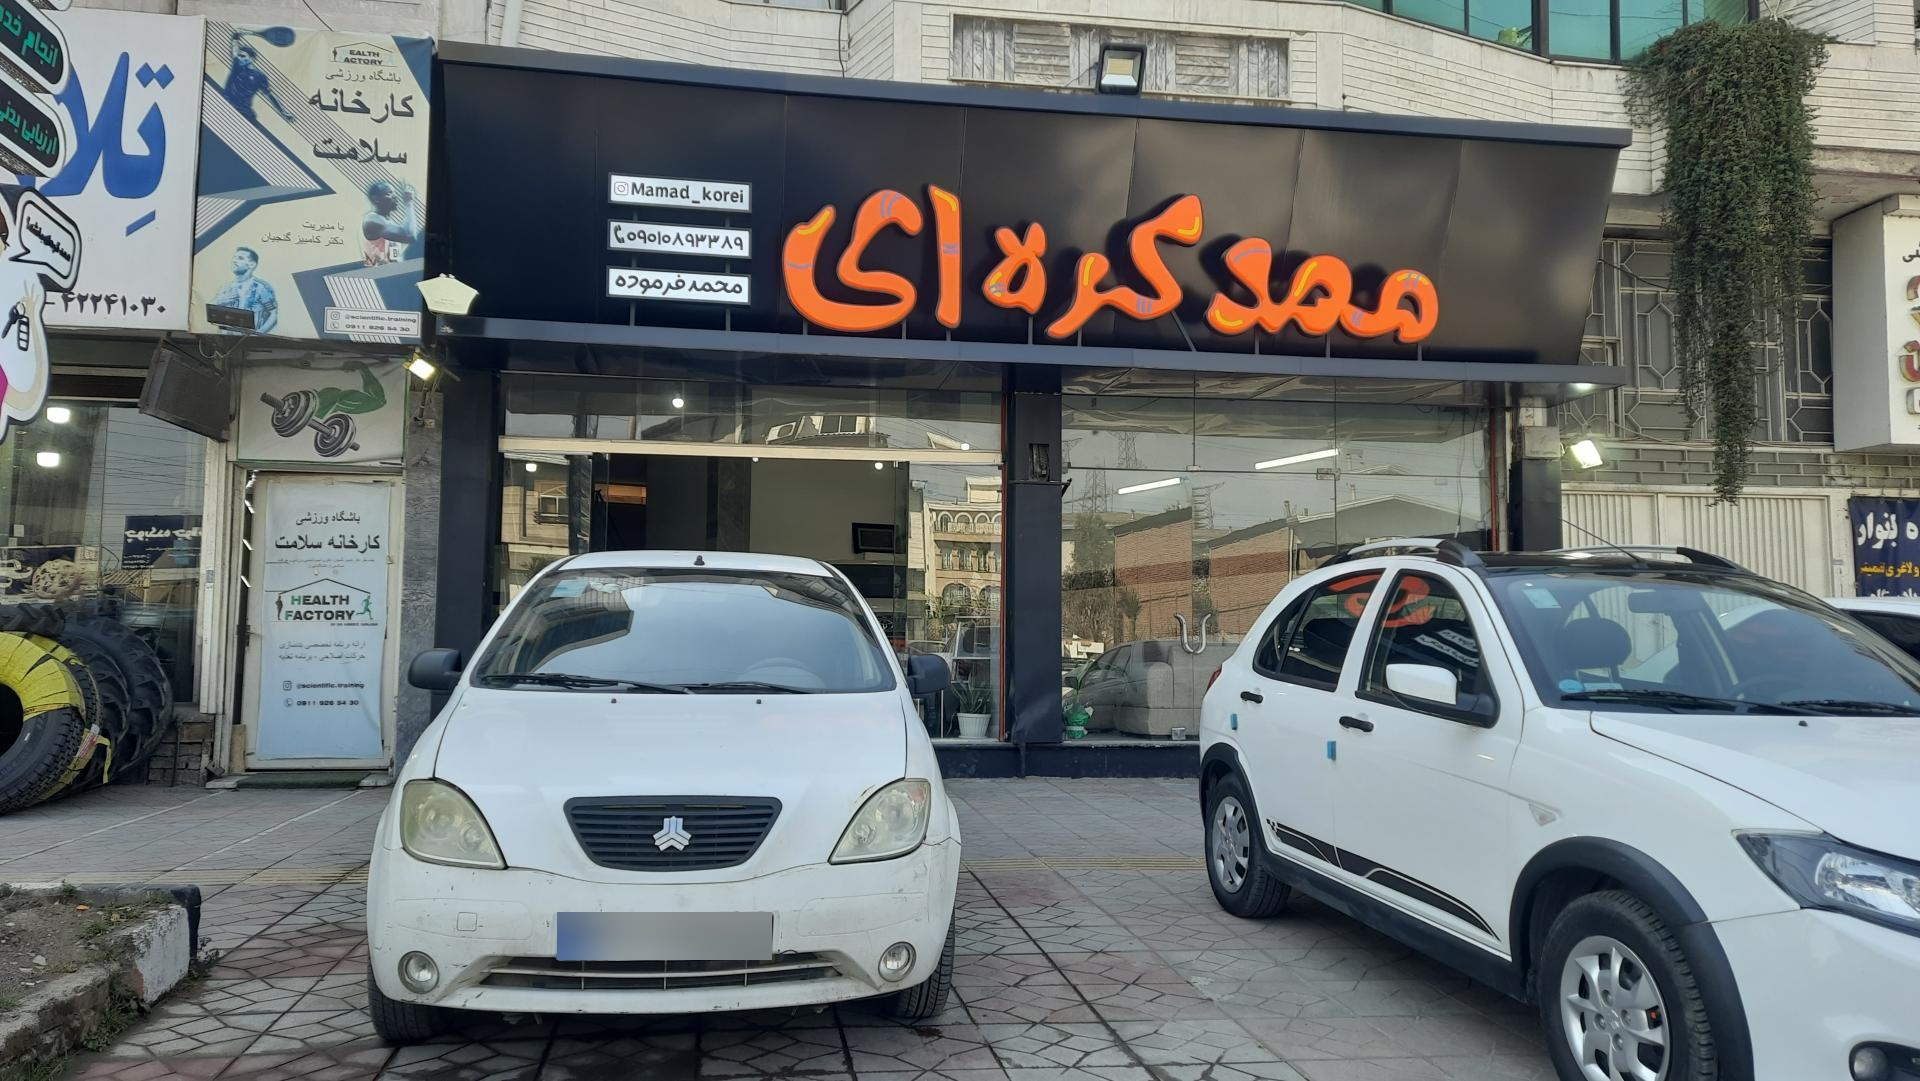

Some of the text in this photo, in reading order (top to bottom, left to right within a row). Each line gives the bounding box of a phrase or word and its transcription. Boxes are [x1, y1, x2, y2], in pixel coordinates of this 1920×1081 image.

[325, 68, 402, 85] باشگاه ورزشی
[308, 87, 414, 124] کارخانه
[313, 137, 407, 164] سلامت
[631, 182, 744, 204] Mamad_korei
[302, 220, 335, 231] مدیریت
[325, 234, 344, 246] دکتر
[781, 183, 963, 332] ای
[981, 193, 1204, 339] کره
[615, 274, 743, 296] محمد فرموده
[295, 510, 361, 526] باشگاه ورزشی
[275, 534, 381, 553] کارخانه سلامت
[290, 595, 350, 605] HEALTH
[285, 610, 356, 621] FACTORY
